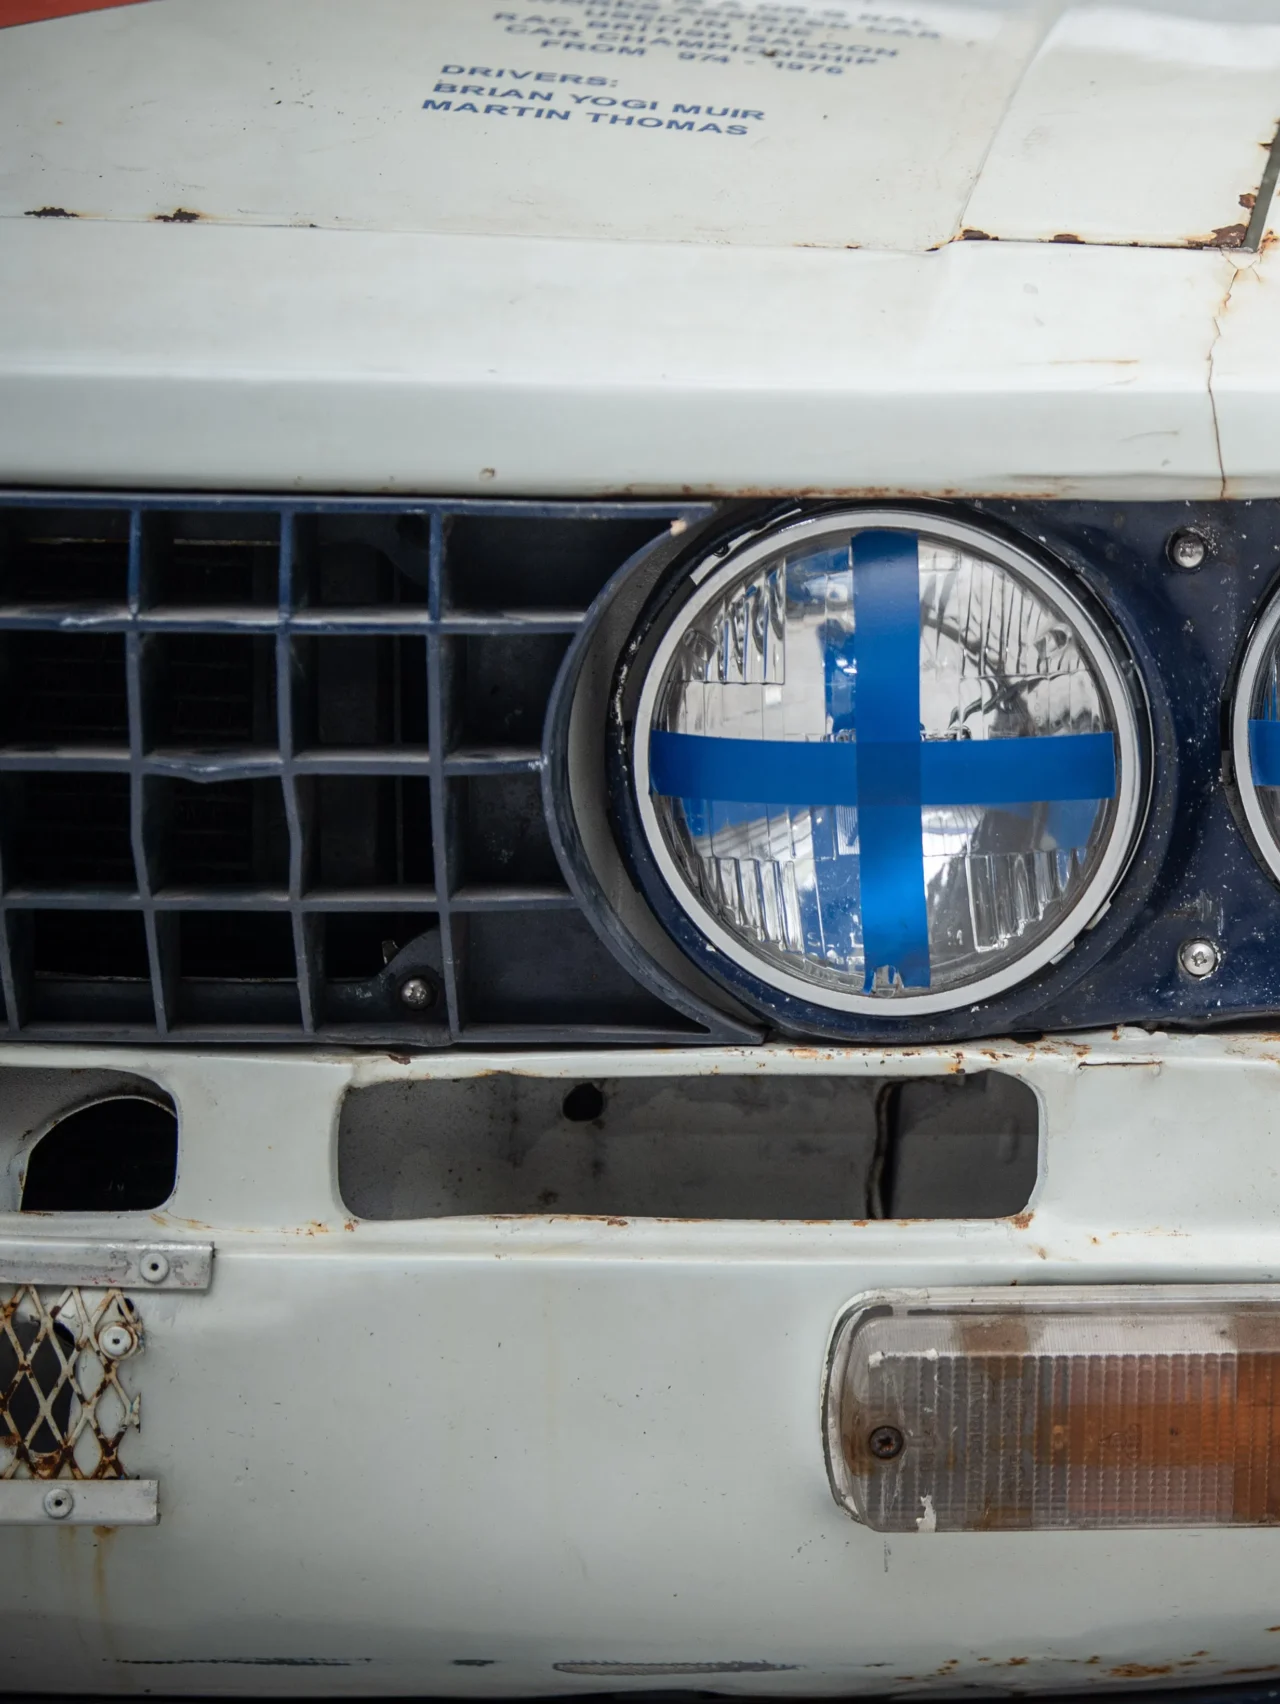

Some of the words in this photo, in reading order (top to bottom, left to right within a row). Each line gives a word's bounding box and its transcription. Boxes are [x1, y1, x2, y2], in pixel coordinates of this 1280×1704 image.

[493, 12, 572, 26] RAC
[586, 20, 732, 41] BRITISH
[747, 35, 898, 57] SALOON
[584, 9, 682, 24] USED
[693, 18, 730, 29] IN
[504, 24, 582, 38] CAR
[596, 32, 878, 65] CHAMPIONSHIP
[541, 39, 647, 56] FROM
[773, 60, 844, 75] 1976
[440, 64, 619, 88] DRIVERS:
[421, 99, 571, 120] MARTIN
[585, 112, 749, 135] THOMAS
[433, 83, 554, 102] BRIAN
[569, 94, 659, 111] YOGI
[672, 103, 765, 120] MUIR
